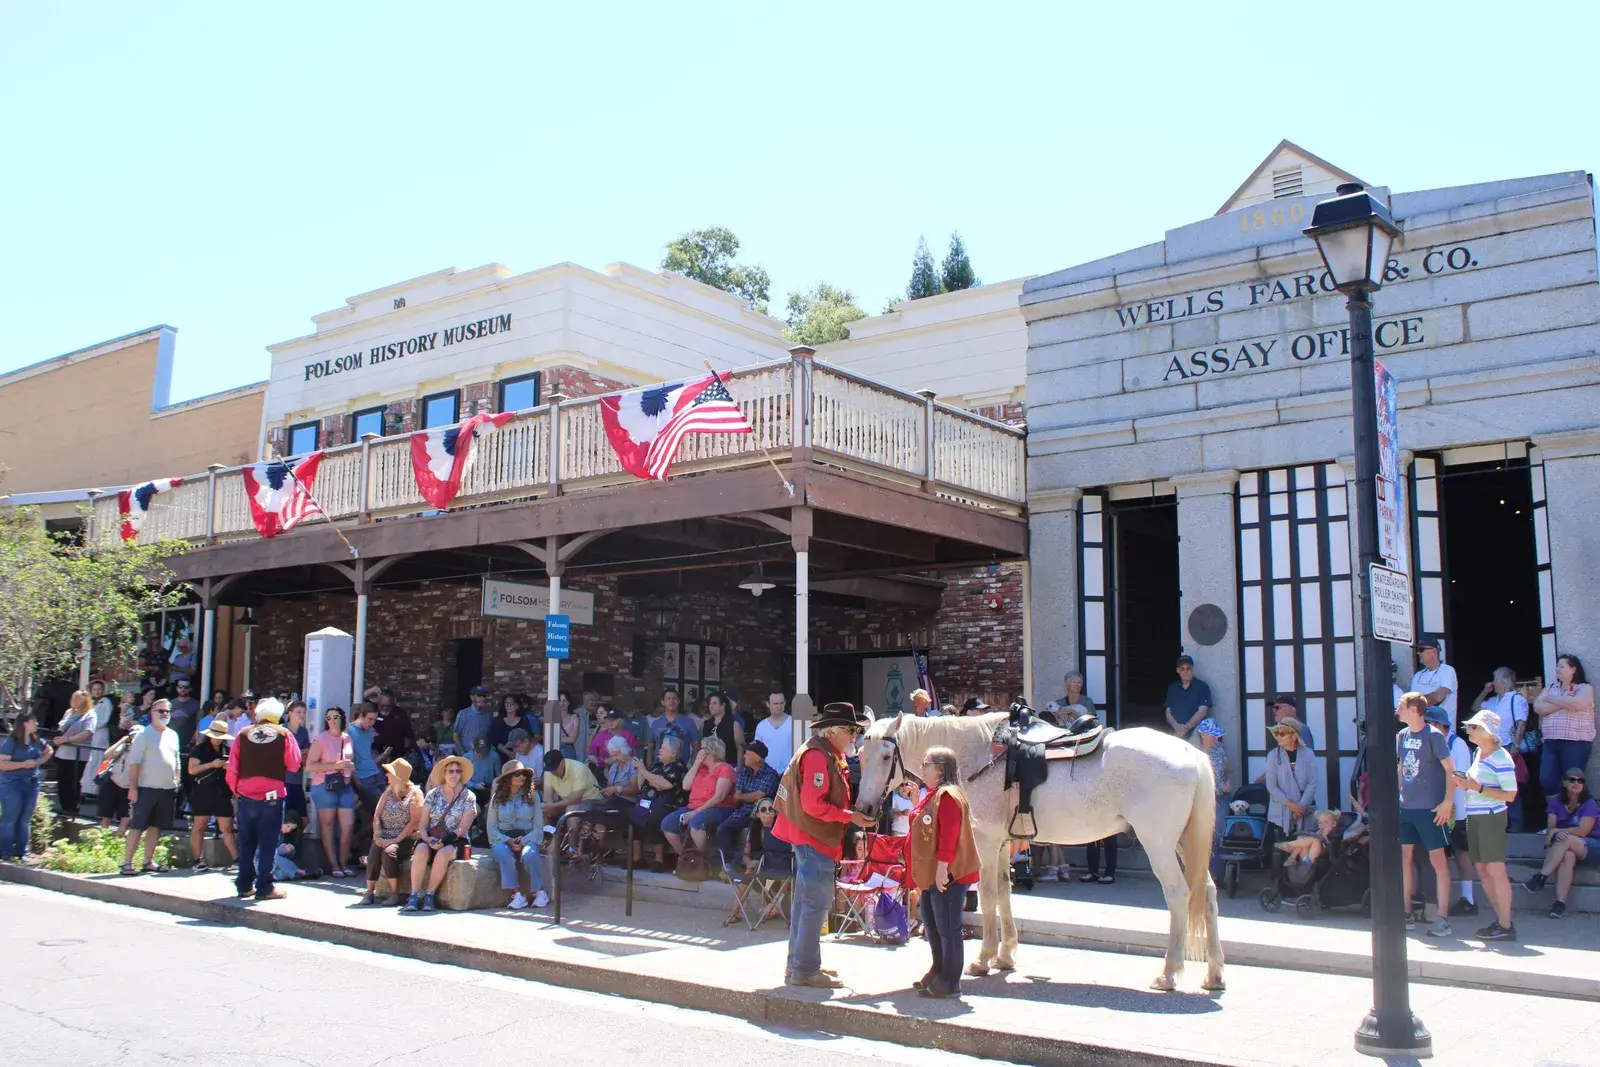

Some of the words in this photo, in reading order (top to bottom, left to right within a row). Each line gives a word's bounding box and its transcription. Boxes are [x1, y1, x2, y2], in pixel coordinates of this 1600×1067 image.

[1240, 203, 1304, 232] 1860
[1115, 290, 1224, 328] WELLS
[1248, 270, 1337, 305] FARG
[1422, 247, 1478, 274] CO.
[304, 351, 363, 382] FOLSOM
[369, 332, 438, 366] HISTORY
[442, 313, 513, 347] MUSEUM
[1162, 339, 1278, 382] ASSAY
[1291, 316, 1425, 360] OFFCE
[499, 593, 538, 607] FOLSOM
[548, 620, 568, 629] Folsom
[547, 632, 568, 641] History
[546, 644, 569, 653] Museum
